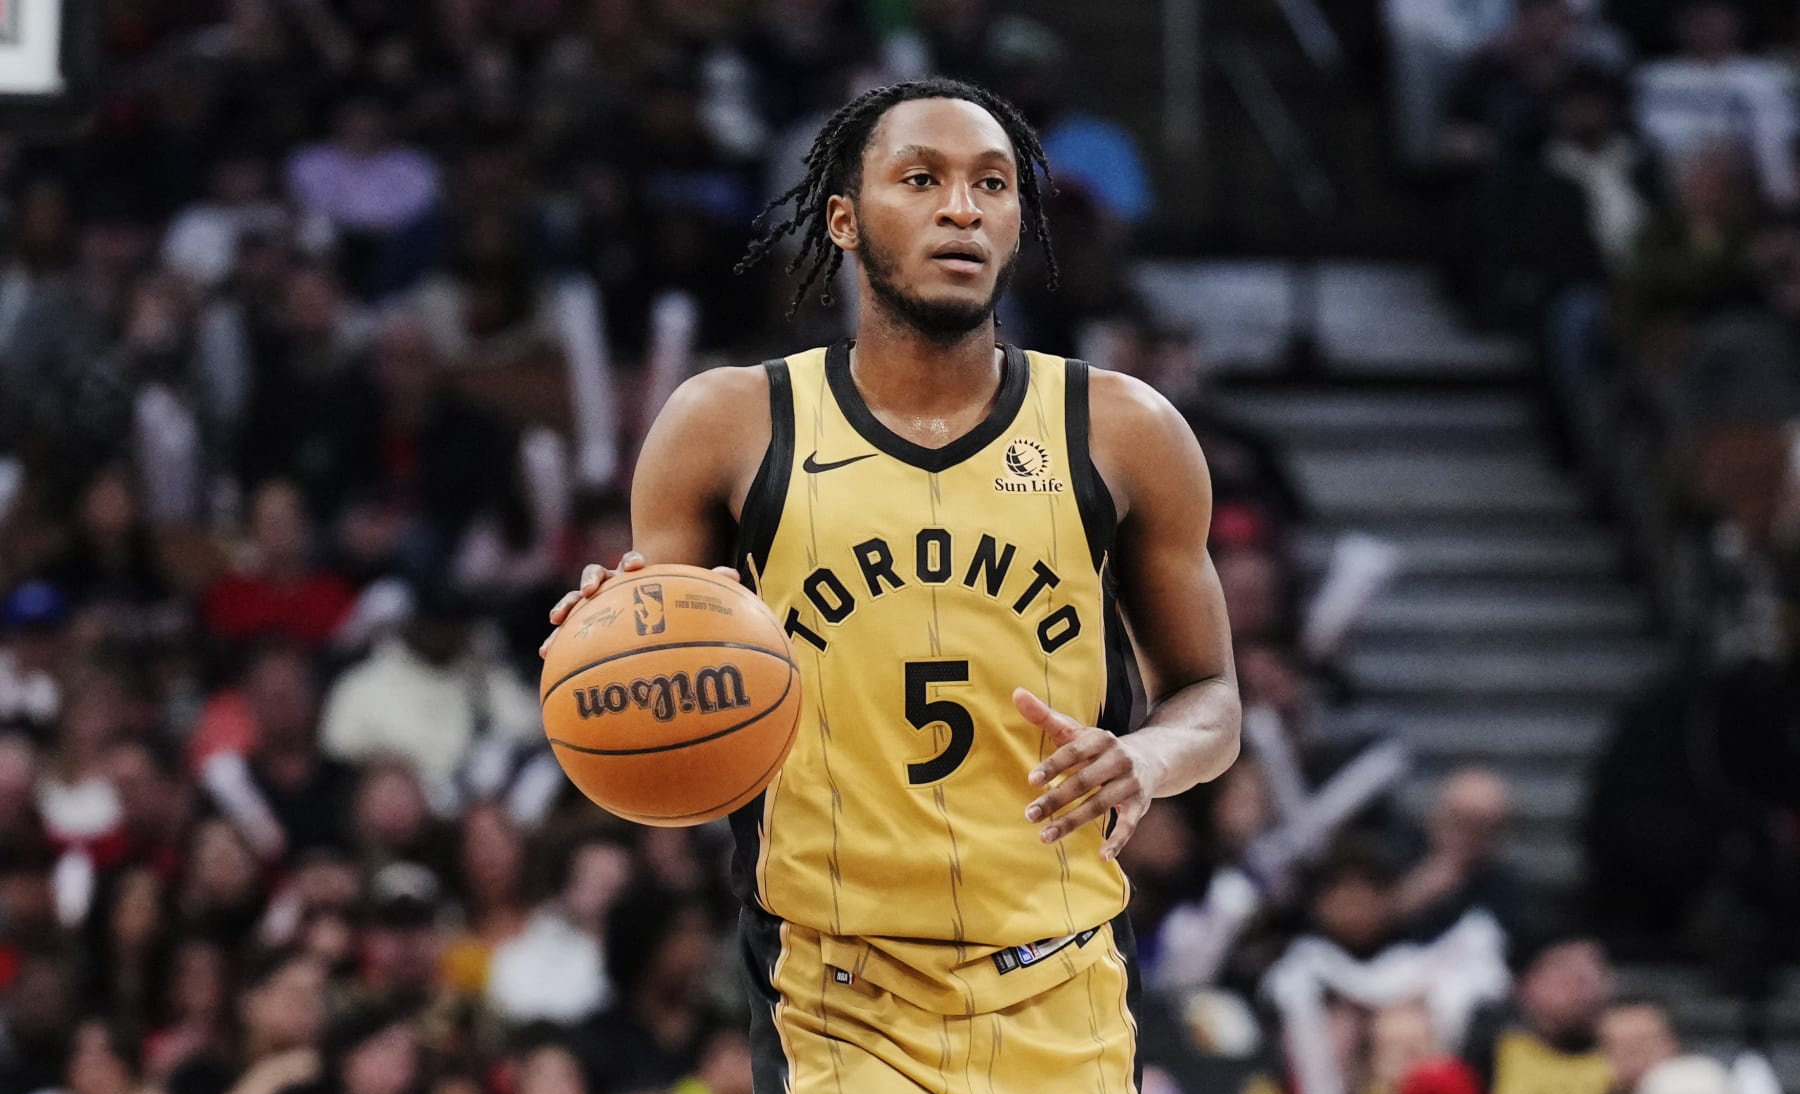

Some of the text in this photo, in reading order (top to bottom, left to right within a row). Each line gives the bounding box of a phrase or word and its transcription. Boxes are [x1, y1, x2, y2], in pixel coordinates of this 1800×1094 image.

[995, 478, 1063, 492] Sun Life
[783, 528, 1081, 653] TORONTO
[573, 664, 750, 722] Wilson
[905, 660, 975, 785] 5
